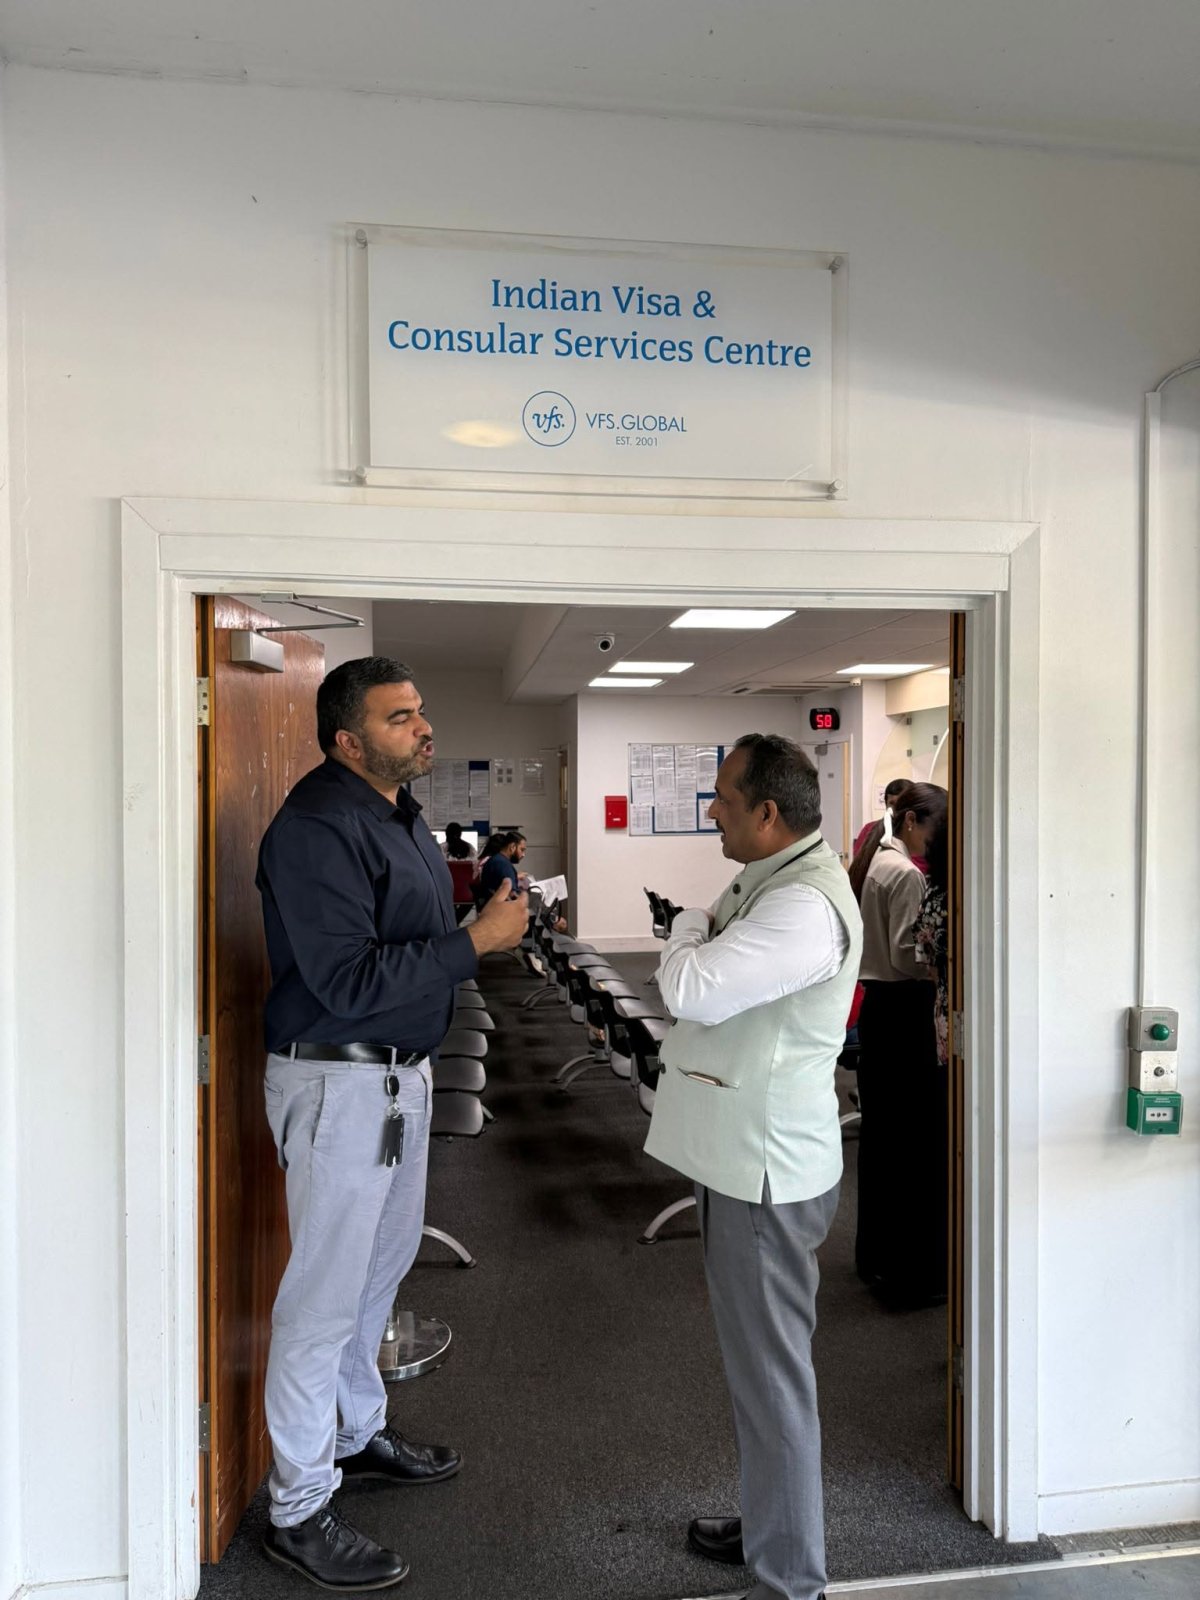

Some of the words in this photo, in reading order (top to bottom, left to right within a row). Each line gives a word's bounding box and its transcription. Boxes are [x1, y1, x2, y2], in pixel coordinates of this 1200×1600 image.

[491, 278, 602, 314] Indian
[612, 286, 682, 317] Visa
[692, 291, 717, 319] &
[387, 320, 543, 357] Consular
[553, 328, 694, 363] Services
[703, 336, 812, 369] Centre
[585, 412, 688, 433] VFS.GLOBAL
[615, 436, 633, 446] EST.
[635, 436, 658, 447] 2001
